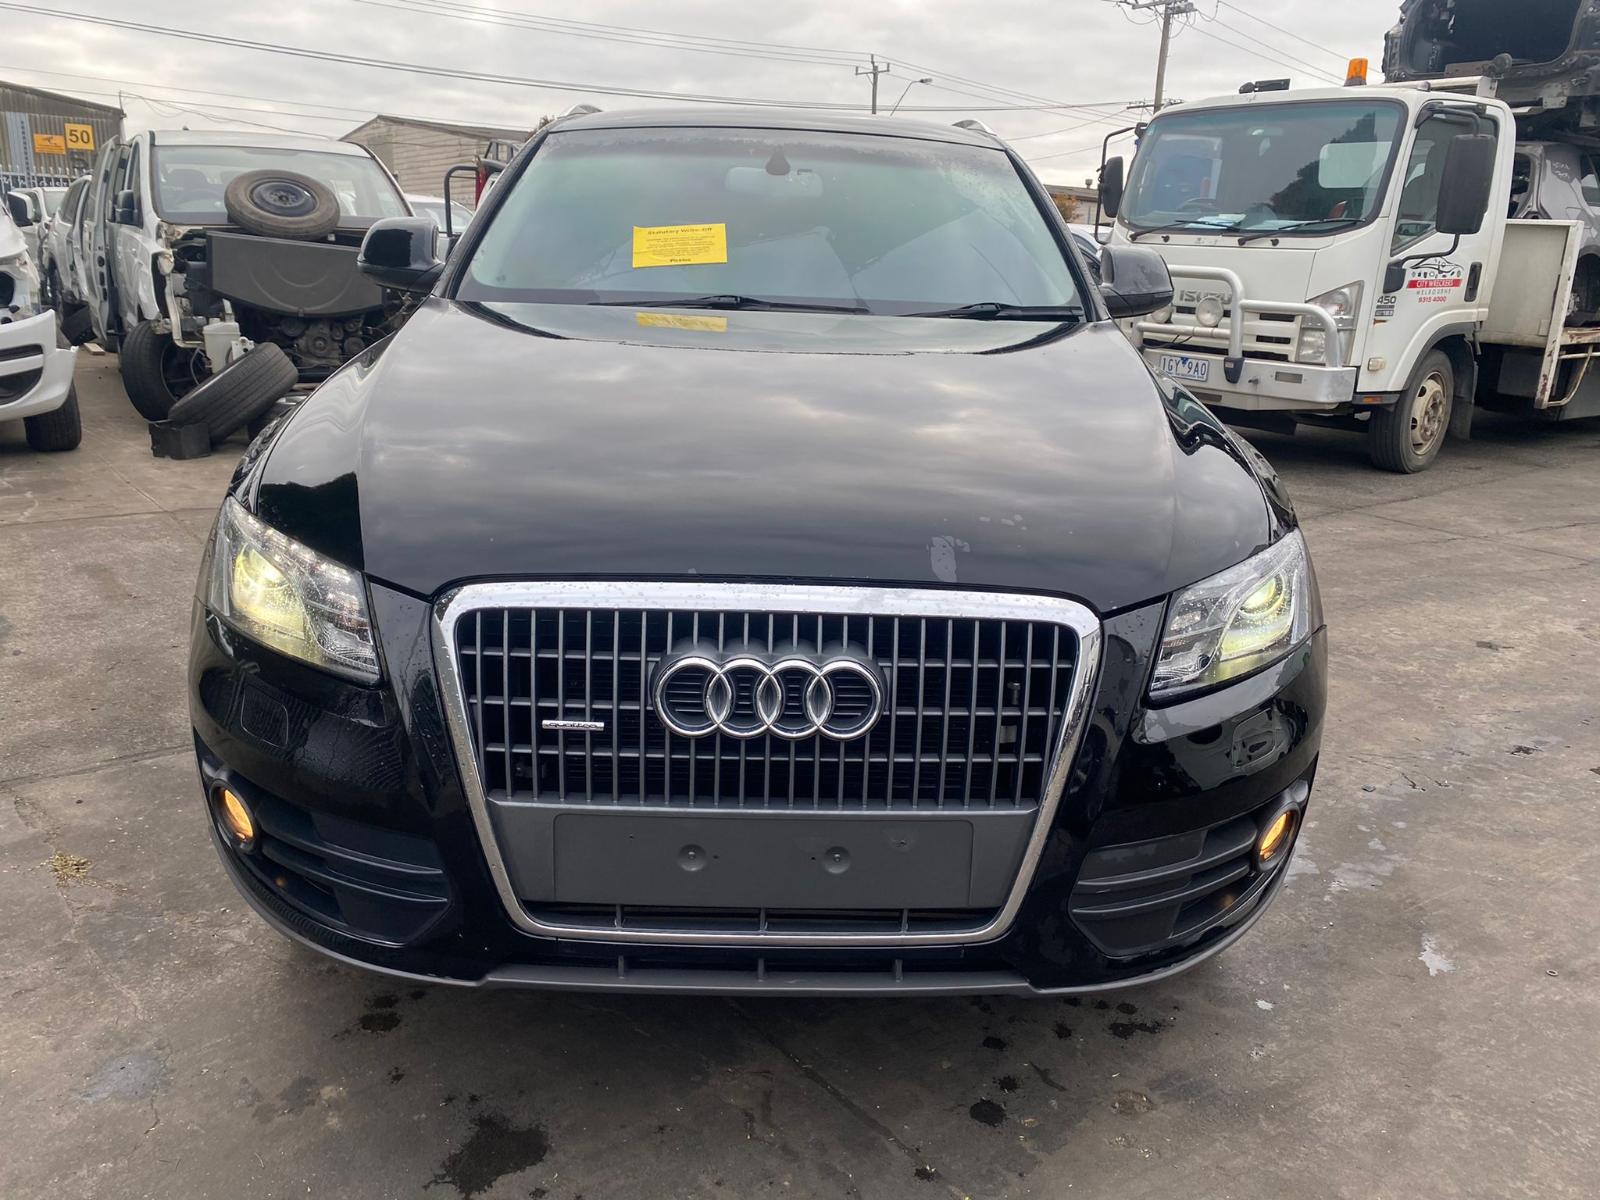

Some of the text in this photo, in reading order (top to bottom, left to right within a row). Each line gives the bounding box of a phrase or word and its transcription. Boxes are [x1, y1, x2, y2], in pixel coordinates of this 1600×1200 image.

[68, 129, 90, 144] 50
[1416, 279, 1454, 288] CITY WRECKERS
[1377, 295, 1397, 304] 450
